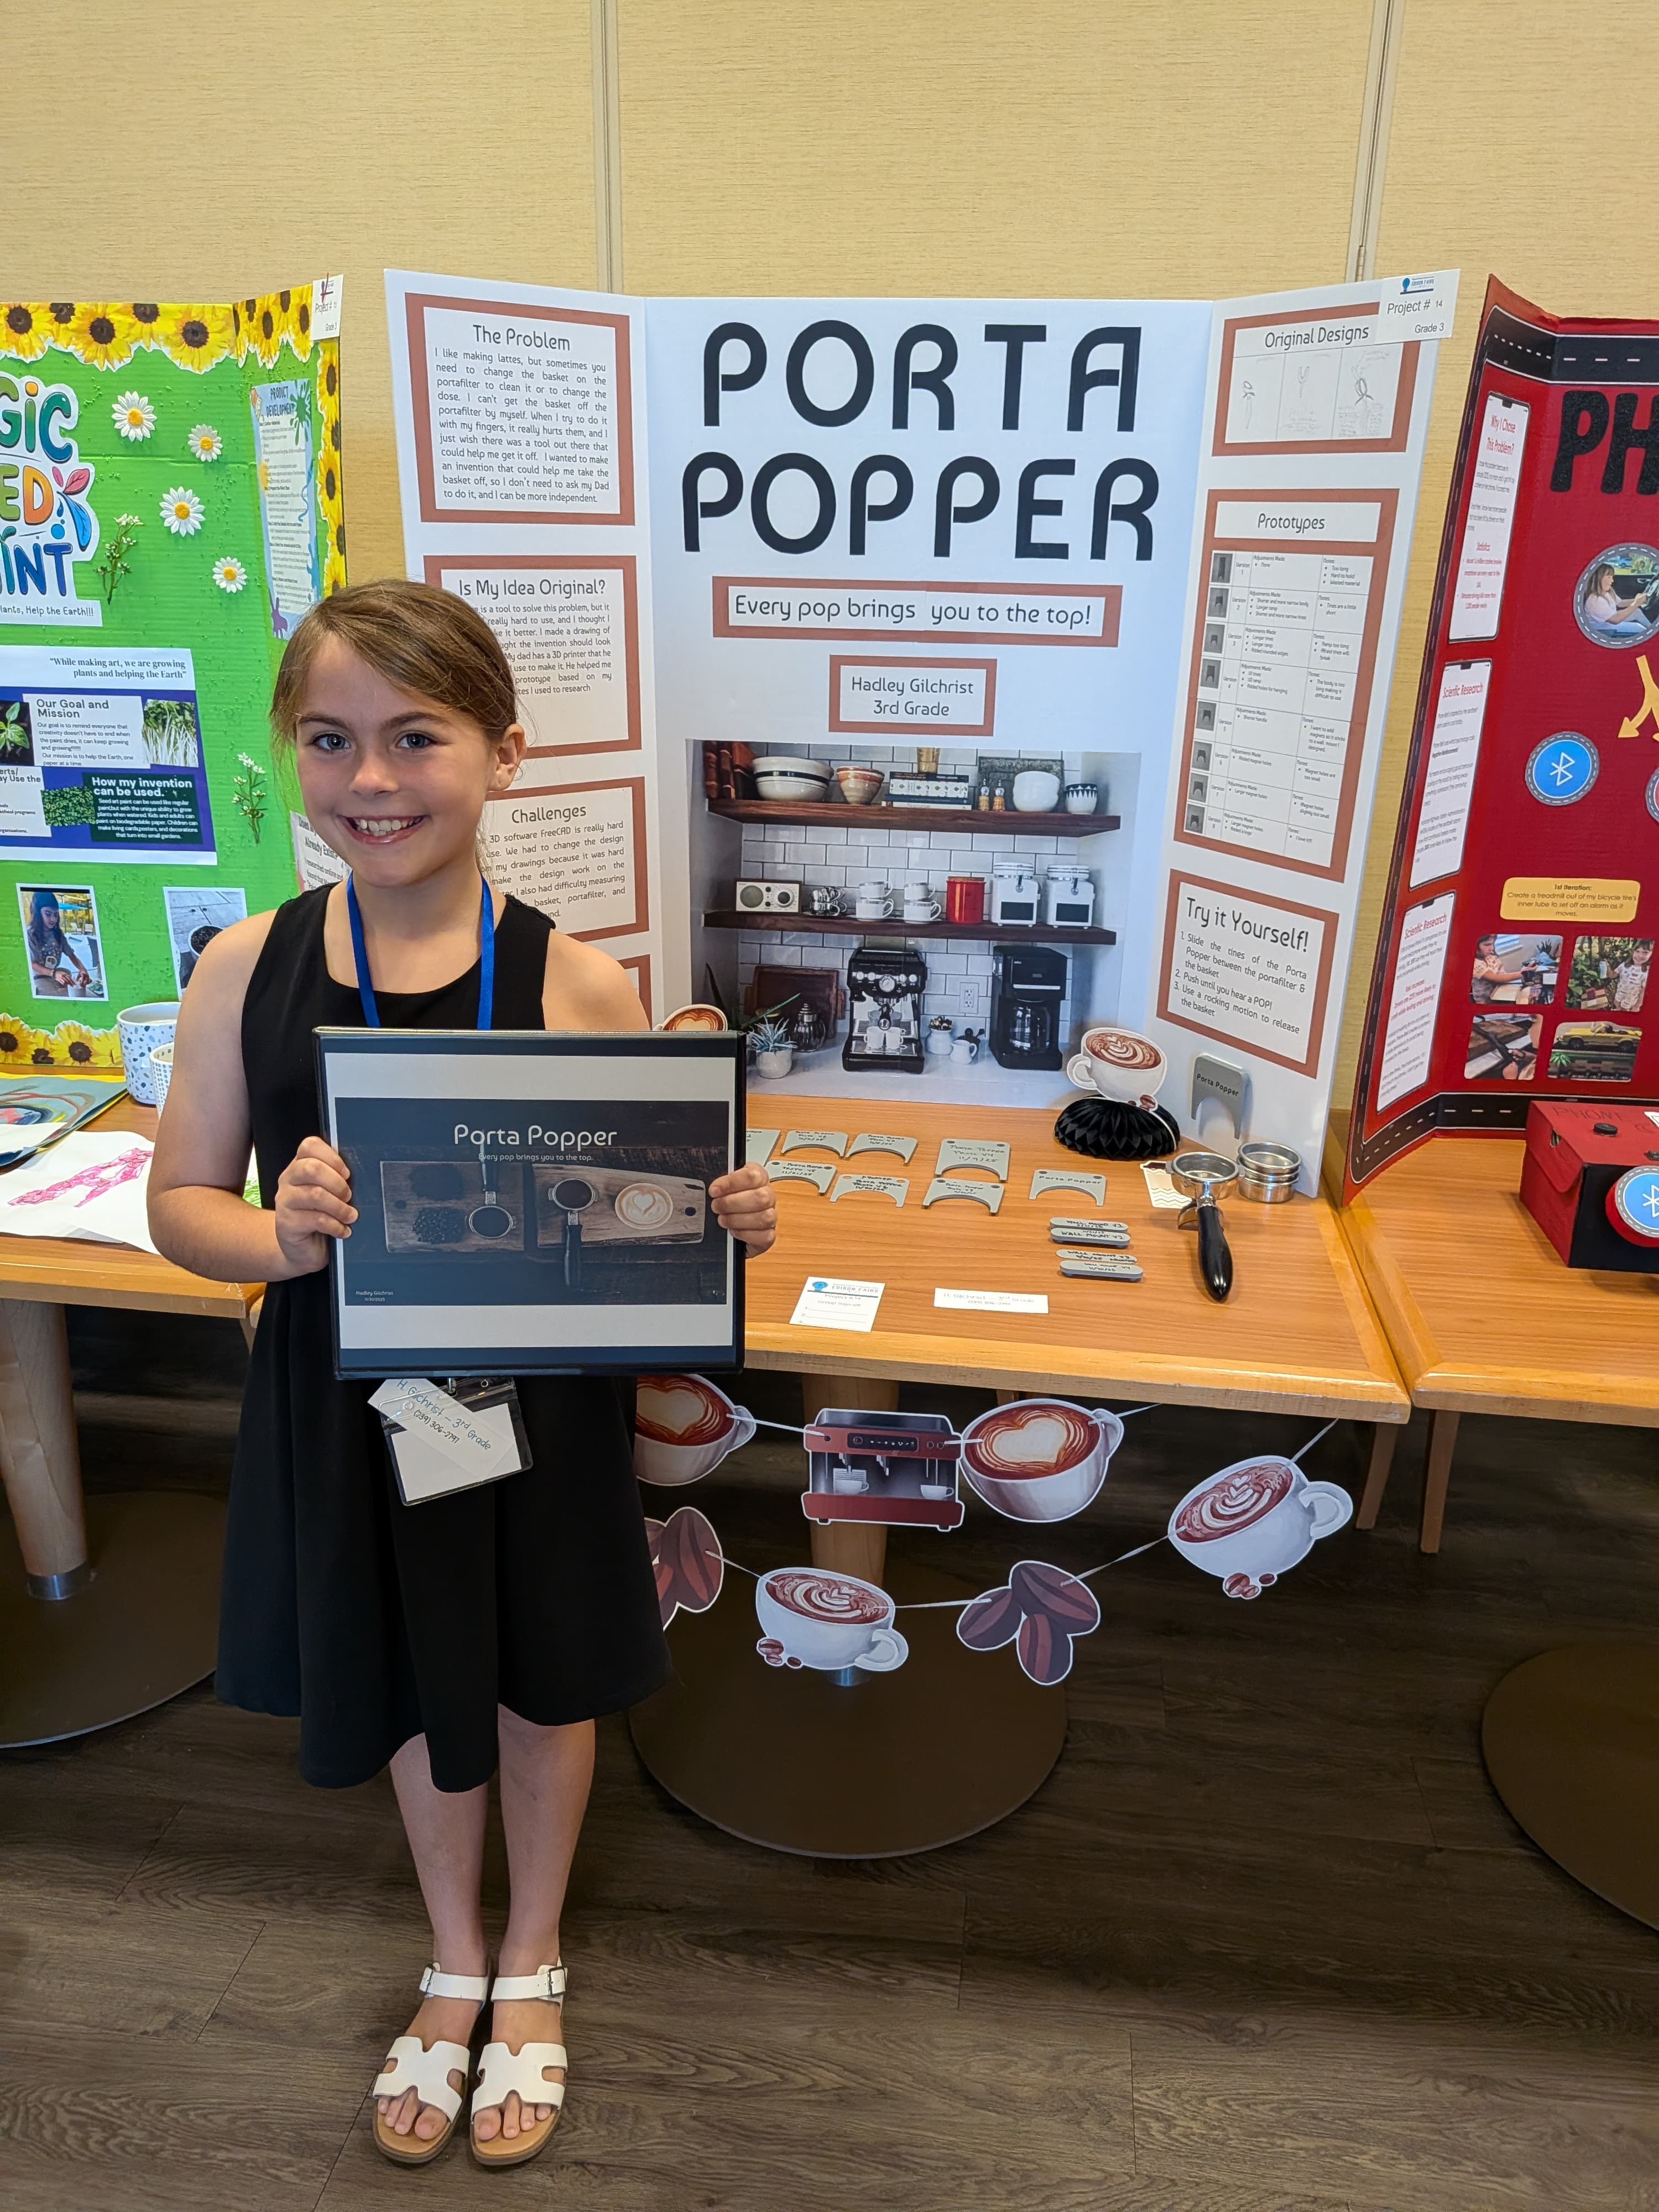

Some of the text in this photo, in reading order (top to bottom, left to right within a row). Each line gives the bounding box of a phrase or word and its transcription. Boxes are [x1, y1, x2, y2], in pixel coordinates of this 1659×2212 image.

[1387, 298, 1443, 316] Project # 14
[1415, 322, 1444, 333] Grade 3
[472, 324, 570, 351] The Problem
[1265, 325, 1369, 351] Original Designs
[435, 346, 606, 373] I like making lattes, but sometimes you
[704, 320, 1141, 432] PORTA
[270, 386, 289, 400] PRODUCT
[266, 403, 296, 418] DEVELOPMENT
[1502, 418, 1516, 434] Chose
[1494, 439, 1515, 456] Problem?
[682, 452, 1159, 561] POPPER
[1258, 513, 1325, 534] Prototypes
[459, 578, 606, 600] Is My Idea Original?
[25, 606, 44, 618] Help
[46, 606, 61, 615] the
[63, 606, 93, 617] Earth!!!
[736, 594, 1091, 630] Every pop brings you to the top!
[77, 658, 107, 669] making
[108, 660, 123, 668] art,
[152, 659, 186, 670] growing
[517, 651, 531, 660] dad
[532, 651, 545, 660] has
[552, 650, 561, 659] 3D
[563, 650, 587, 661] printer
[602, 649, 611, 657] he
[73, 669, 97, 679] plants
[114, 669, 145, 680] helping
[852, 676, 974, 696] Hadley Gilchrist
[36, 698, 109, 709] Our Goal and
[37, 708, 80, 718] Mission
[873, 700, 950, 716] 3rd Grade
[91, 776, 192, 790] How my invention
[116, 786, 132, 796] be
[134, 788, 164, 797] used.
[512, 806, 586, 823] Challenges
[489, 834, 500, 844] 3D
[504, 832, 538, 842] software
[584, 823, 604, 833] really
[607, 820, 623, 830] hard
[1187, 897, 1308, 950] Try it Yourself!
[1181, 931, 1307, 979] 1. Slide the tines of the Porta
[1175, 969, 1181, 978] 2.
[1183, 972, 1199, 985] Push
[1200, 979, 1215, 990] until
[1217, 985, 1230, 995] you
[1230, 988, 1247, 1001] hear
[1253, 997, 1272, 1010] POP!
[1197, 1073, 1239, 1096] Porta Popper
[453, 1124, 617, 1152] Porta Popper
[478, 1152, 498, 1162] Every
[516, 1153, 539, 1162] brings
[396, 1378, 492, 1451] H. Gilchrist 3rd Grade
[413, 1409, 460, 1444] (239) 306-2797
